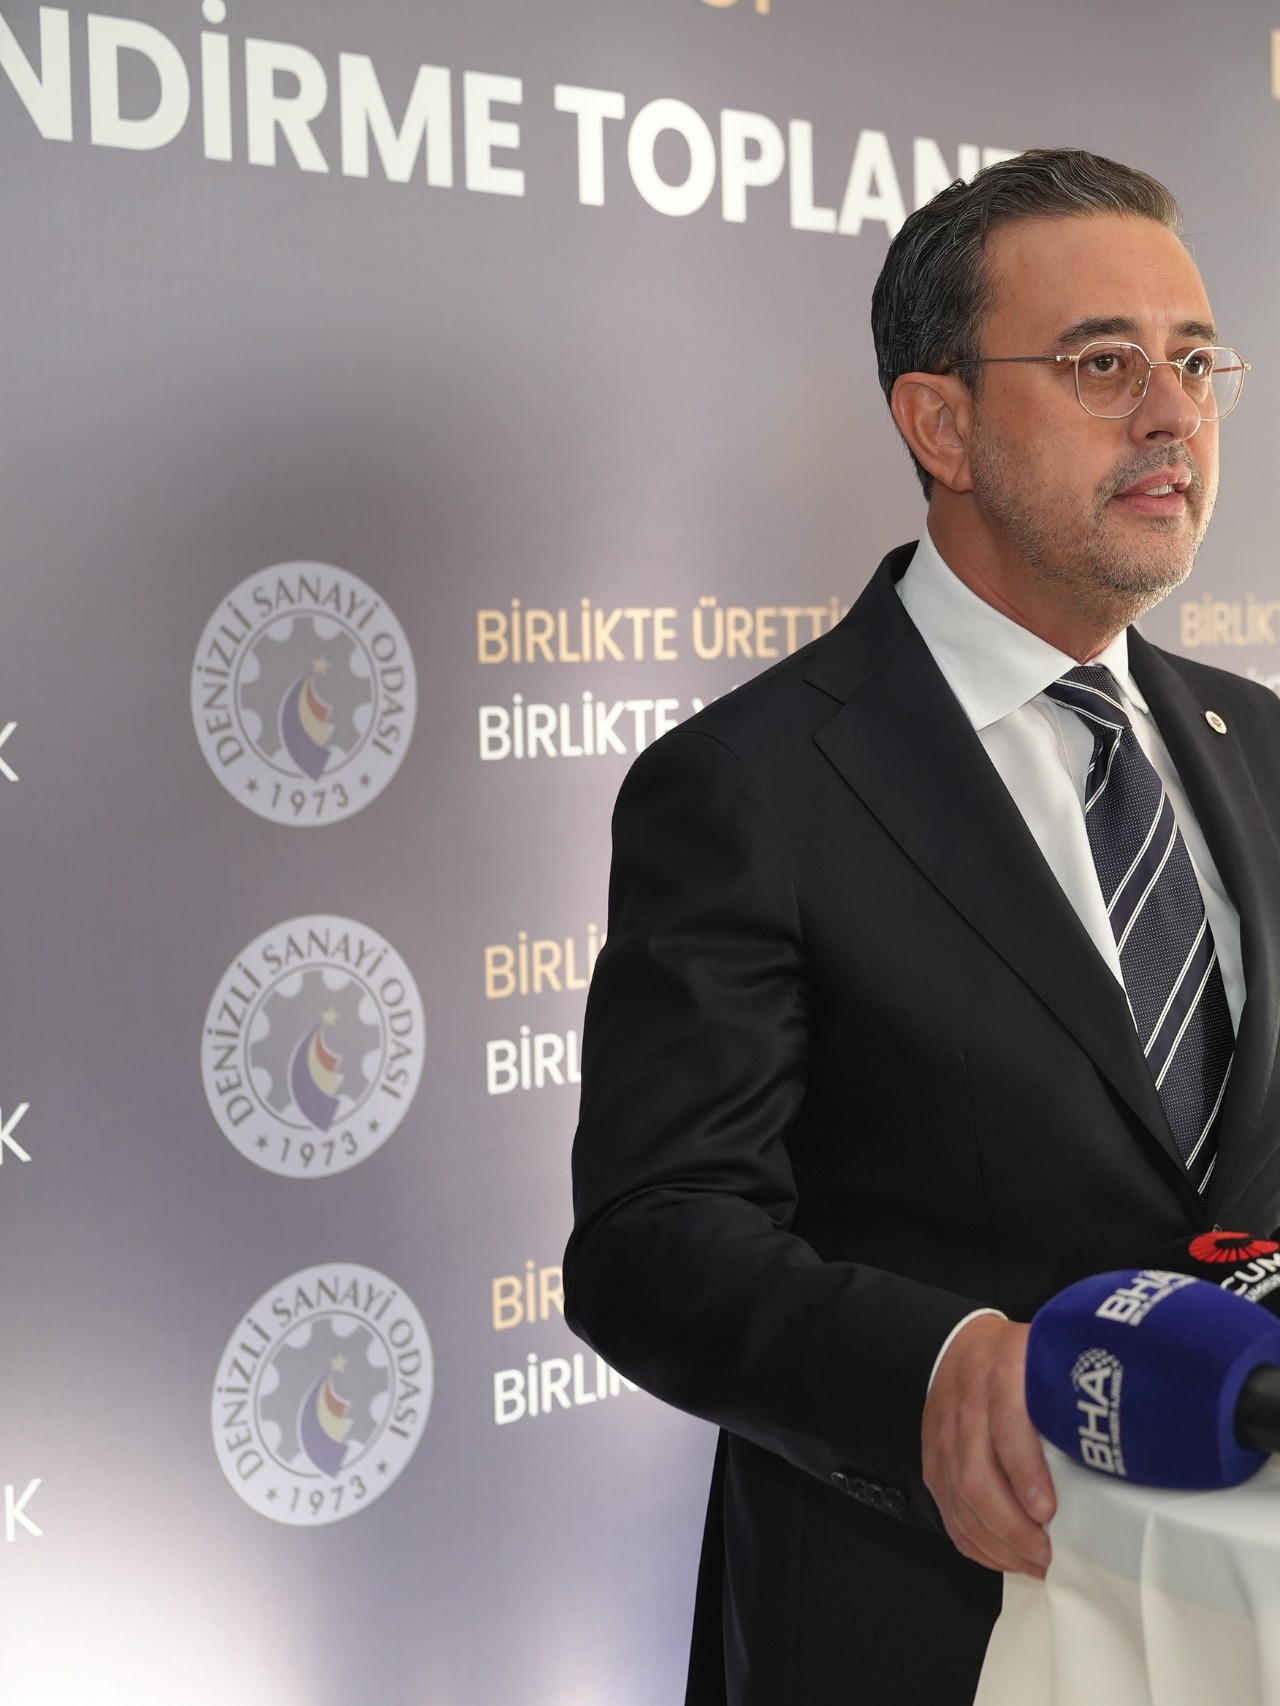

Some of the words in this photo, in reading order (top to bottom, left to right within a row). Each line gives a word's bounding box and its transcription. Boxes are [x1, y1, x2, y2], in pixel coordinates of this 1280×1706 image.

[554, 84, 1025, 237] TOPLAN
[477, 597, 678, 663] BİRLİKTE
[693, 594, 851, 660] ÜRETTİ
[198, 601, 253, 768] DENİZLİ
[253, 575, 380, 629] SANAYİ
[370, 631, 405, 757] ODASI
[271, 783, 349, 816] 1973
[485, 923, 608, 1000] BİRLİ
[207, 961, 262, 1127] DENİZLİ
[262, 928, 389, 977] SANAYİ
[380, 977, 413, 1100] ODASI
[280, 1131, 358, 1168] 1973
[1095, 1270, 1188, 1323] BHA
[217, 1319, 272, 1481] DENİZLİ
[272, 1276, 397, 1327] SANAYİ
[388, 1318, 423, 1439] ODASI
[1077, 1366, 1116, 1473] BHA
[4, 1477, 44, 1543] K
[290, 1476, 367, 1517] 1973
